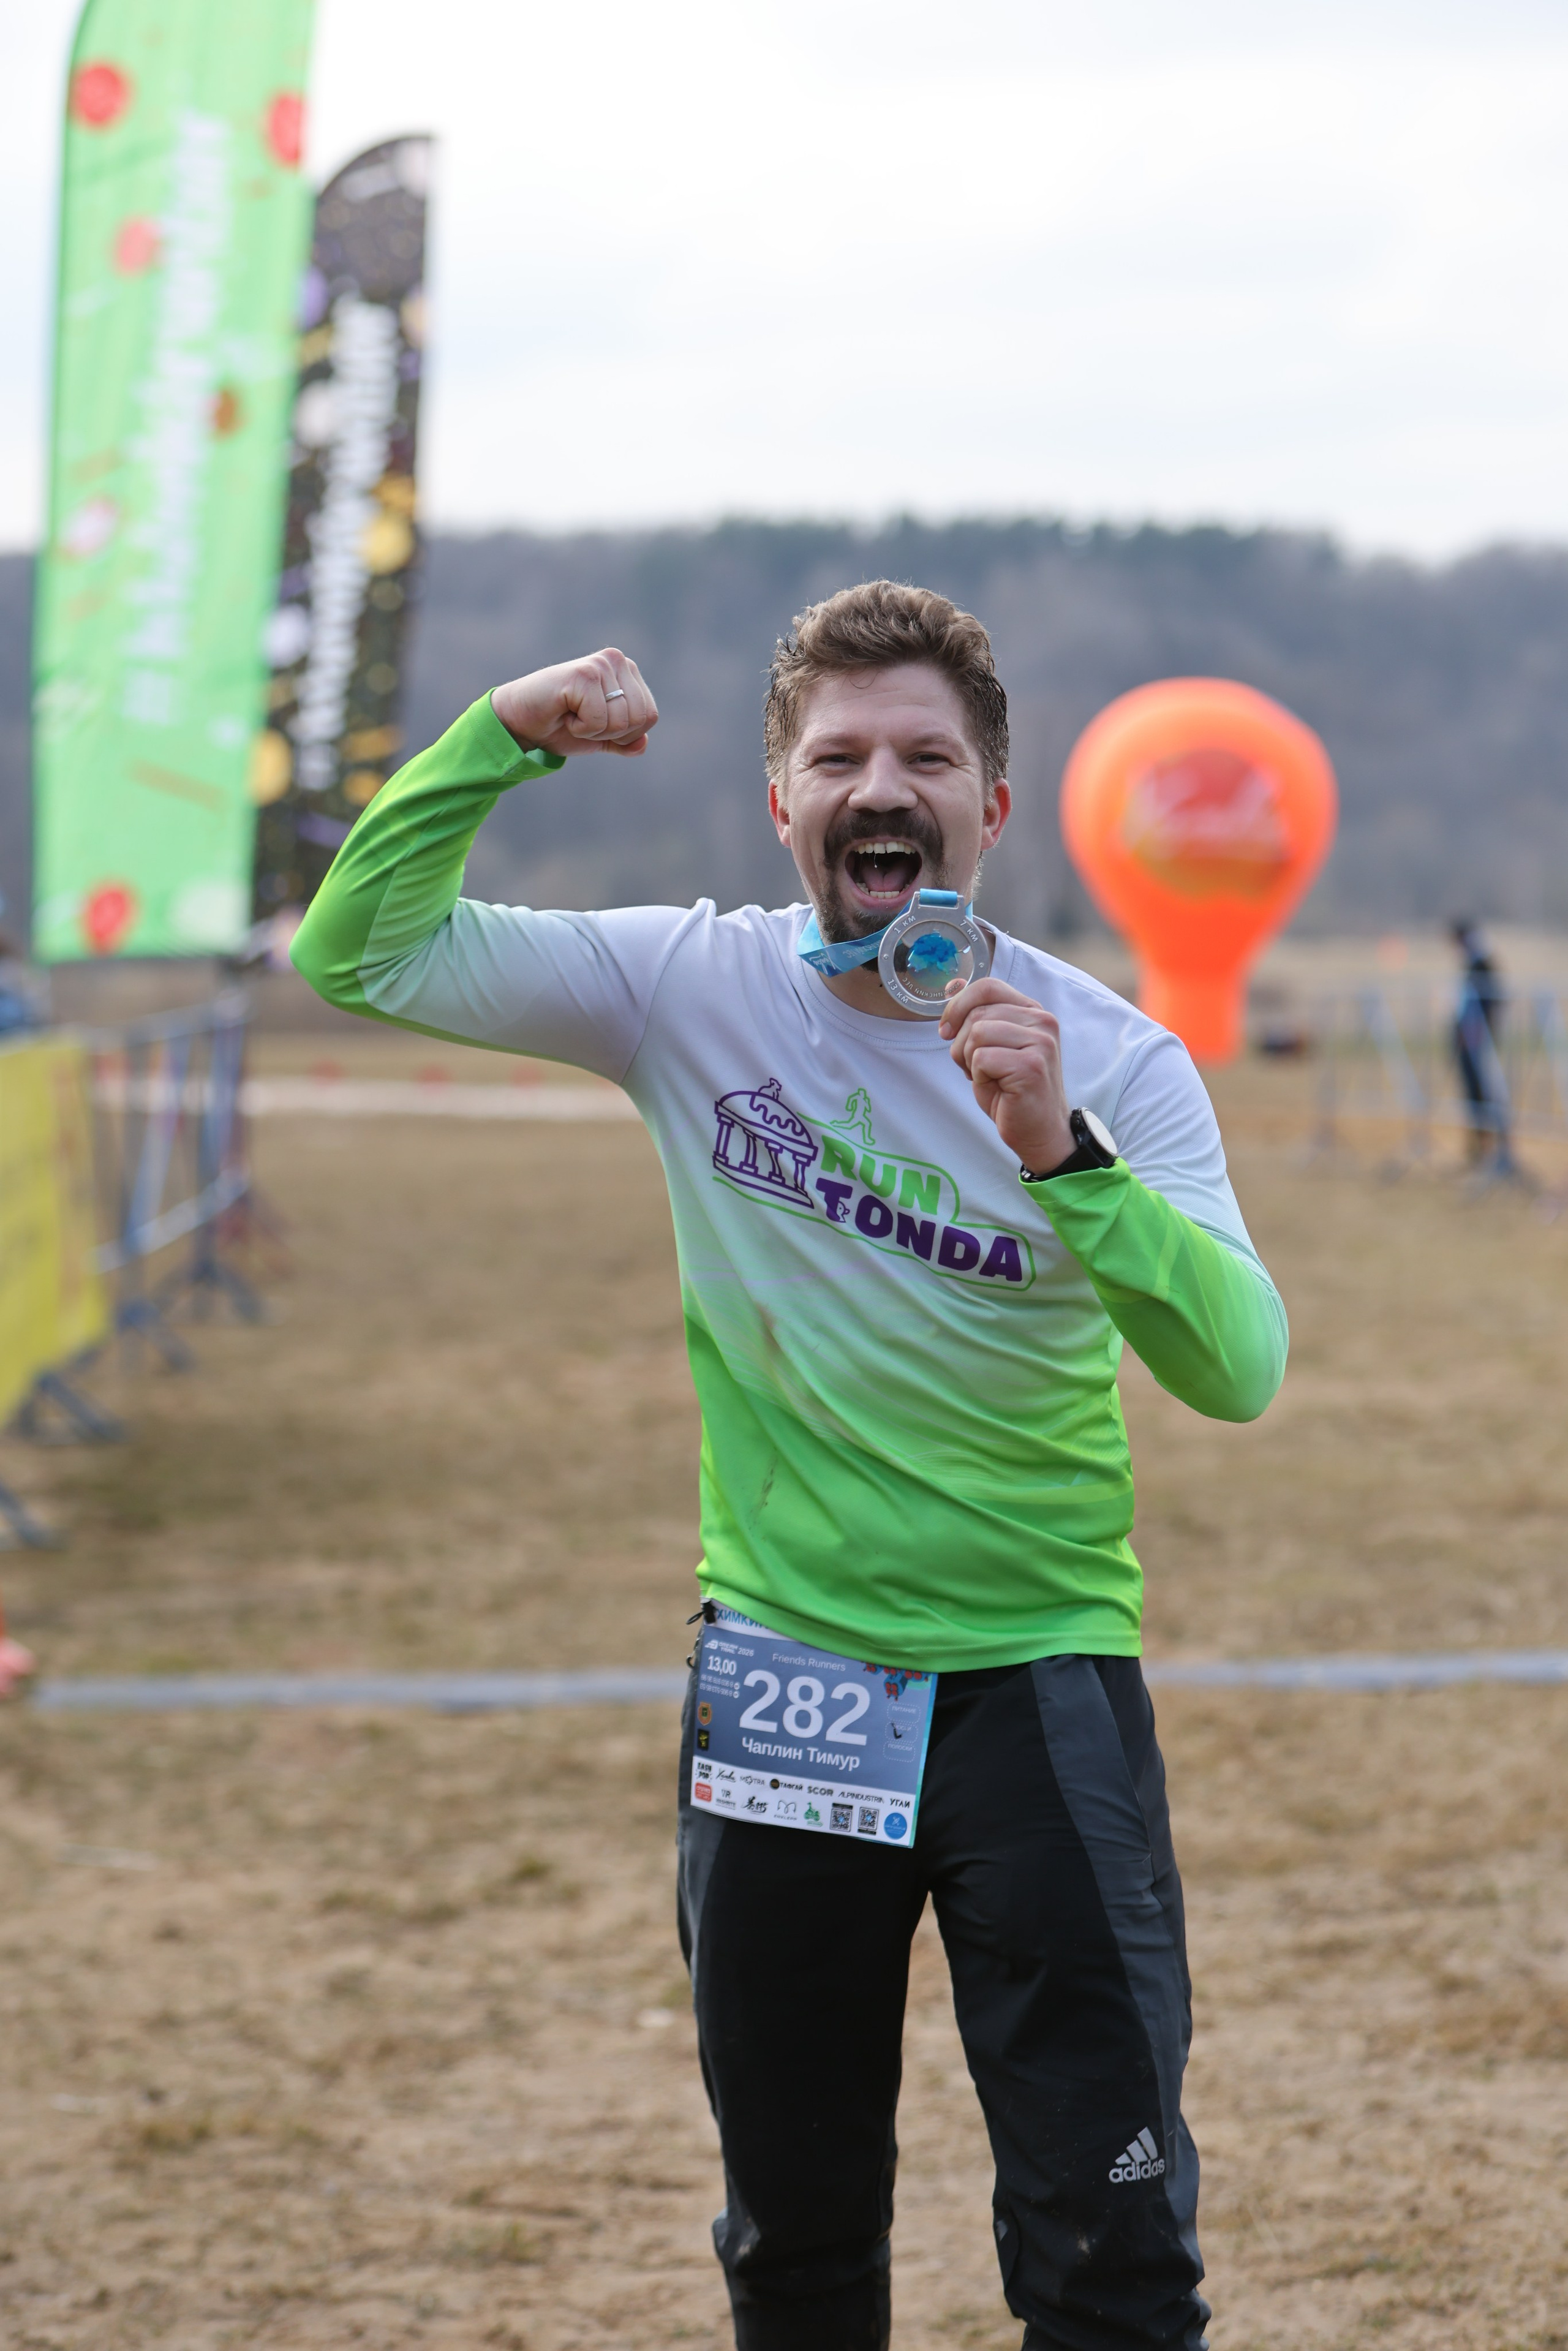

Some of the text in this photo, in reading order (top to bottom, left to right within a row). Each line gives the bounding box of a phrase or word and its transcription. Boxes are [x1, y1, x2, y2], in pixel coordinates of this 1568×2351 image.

[888, 979, 897, 991] 13
[820, 1134, 941, 1215] RUN
[815, 1177, 1023, 1282] TONDA
[737, 1648, 755, 1657] 2026
[772, 1653, 846, 1672] Friends Runners
[739, 1669, 870, 1746] 282
[742, 1736, 860, 1772] Чаплин Тимур
[780, 1782, 803, 1791] ТАФГАЙ
[807, 1786, 834, 1797] SCOR
[1109, 2158, 1165, 2183] adidas
